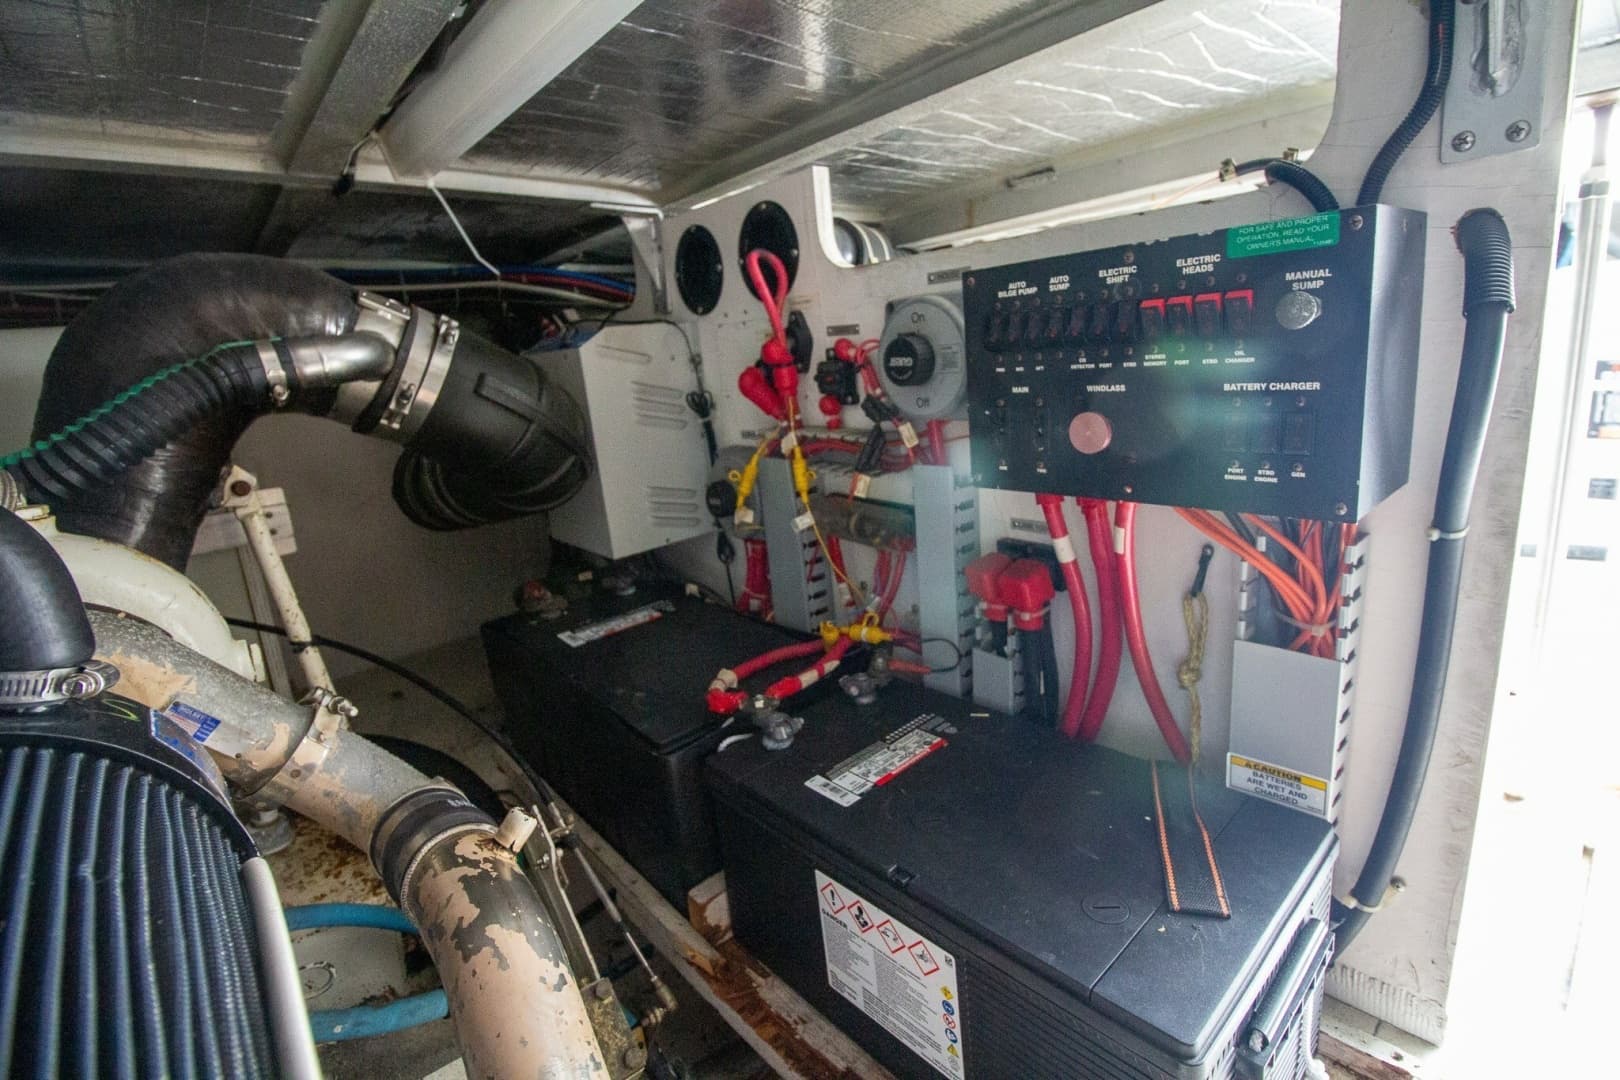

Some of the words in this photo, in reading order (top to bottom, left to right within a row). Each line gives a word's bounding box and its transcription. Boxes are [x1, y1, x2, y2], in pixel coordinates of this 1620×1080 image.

[1239, 226, 1255, 234] FOR
[1256, 222, 1274, 232] SAFE
[1276, 220, 1293, 228] AND
[1294, 215, 1329, 226] PROPER
[1282, 227, 1305, 236] READ
[1307, 223, 1330, 232] YOUR
[1246, 239, 1281, 250] OWNER'S
[1176, 254, 1221, 267] ELECTRIC
[1099, 266, 1137, 277] ELECTRIC
[1182, 263, 1214, 275] HEADS
[1049, 275, 1070, 284] AUTO
[1106, 274, 1130, 284] SHIFT
[1285, 269, 1332, 281] MANUAL
[1008, 281, 1027, 290] AUTO
[1049, 283, 1070, 292] SUMP
[1291, 280, 1325, 291] SUMP
[998, 289, 1017, 299] BILGE
[1018, 286, 1038, 296] PUMP
[911, 312, 926, 323] On
[1012, 385, 1029, 393] MAIN
[1086, 384, 1126, 392] WINDLASS
[1223, 382, 1268, 391] BATTERY
[1269, 381, 1321, 391] CHARGER
[1253, 763, 1302, 782] CAUTION
[1252, 771, 1302, 790] BATTERIES
[1247, 776, 1263, 787] ARE
[1266, 782, 1286, 793] WET
[1288, 789, 1308, 800] AND
[1254, 786, 1298, 805] CHARGED
